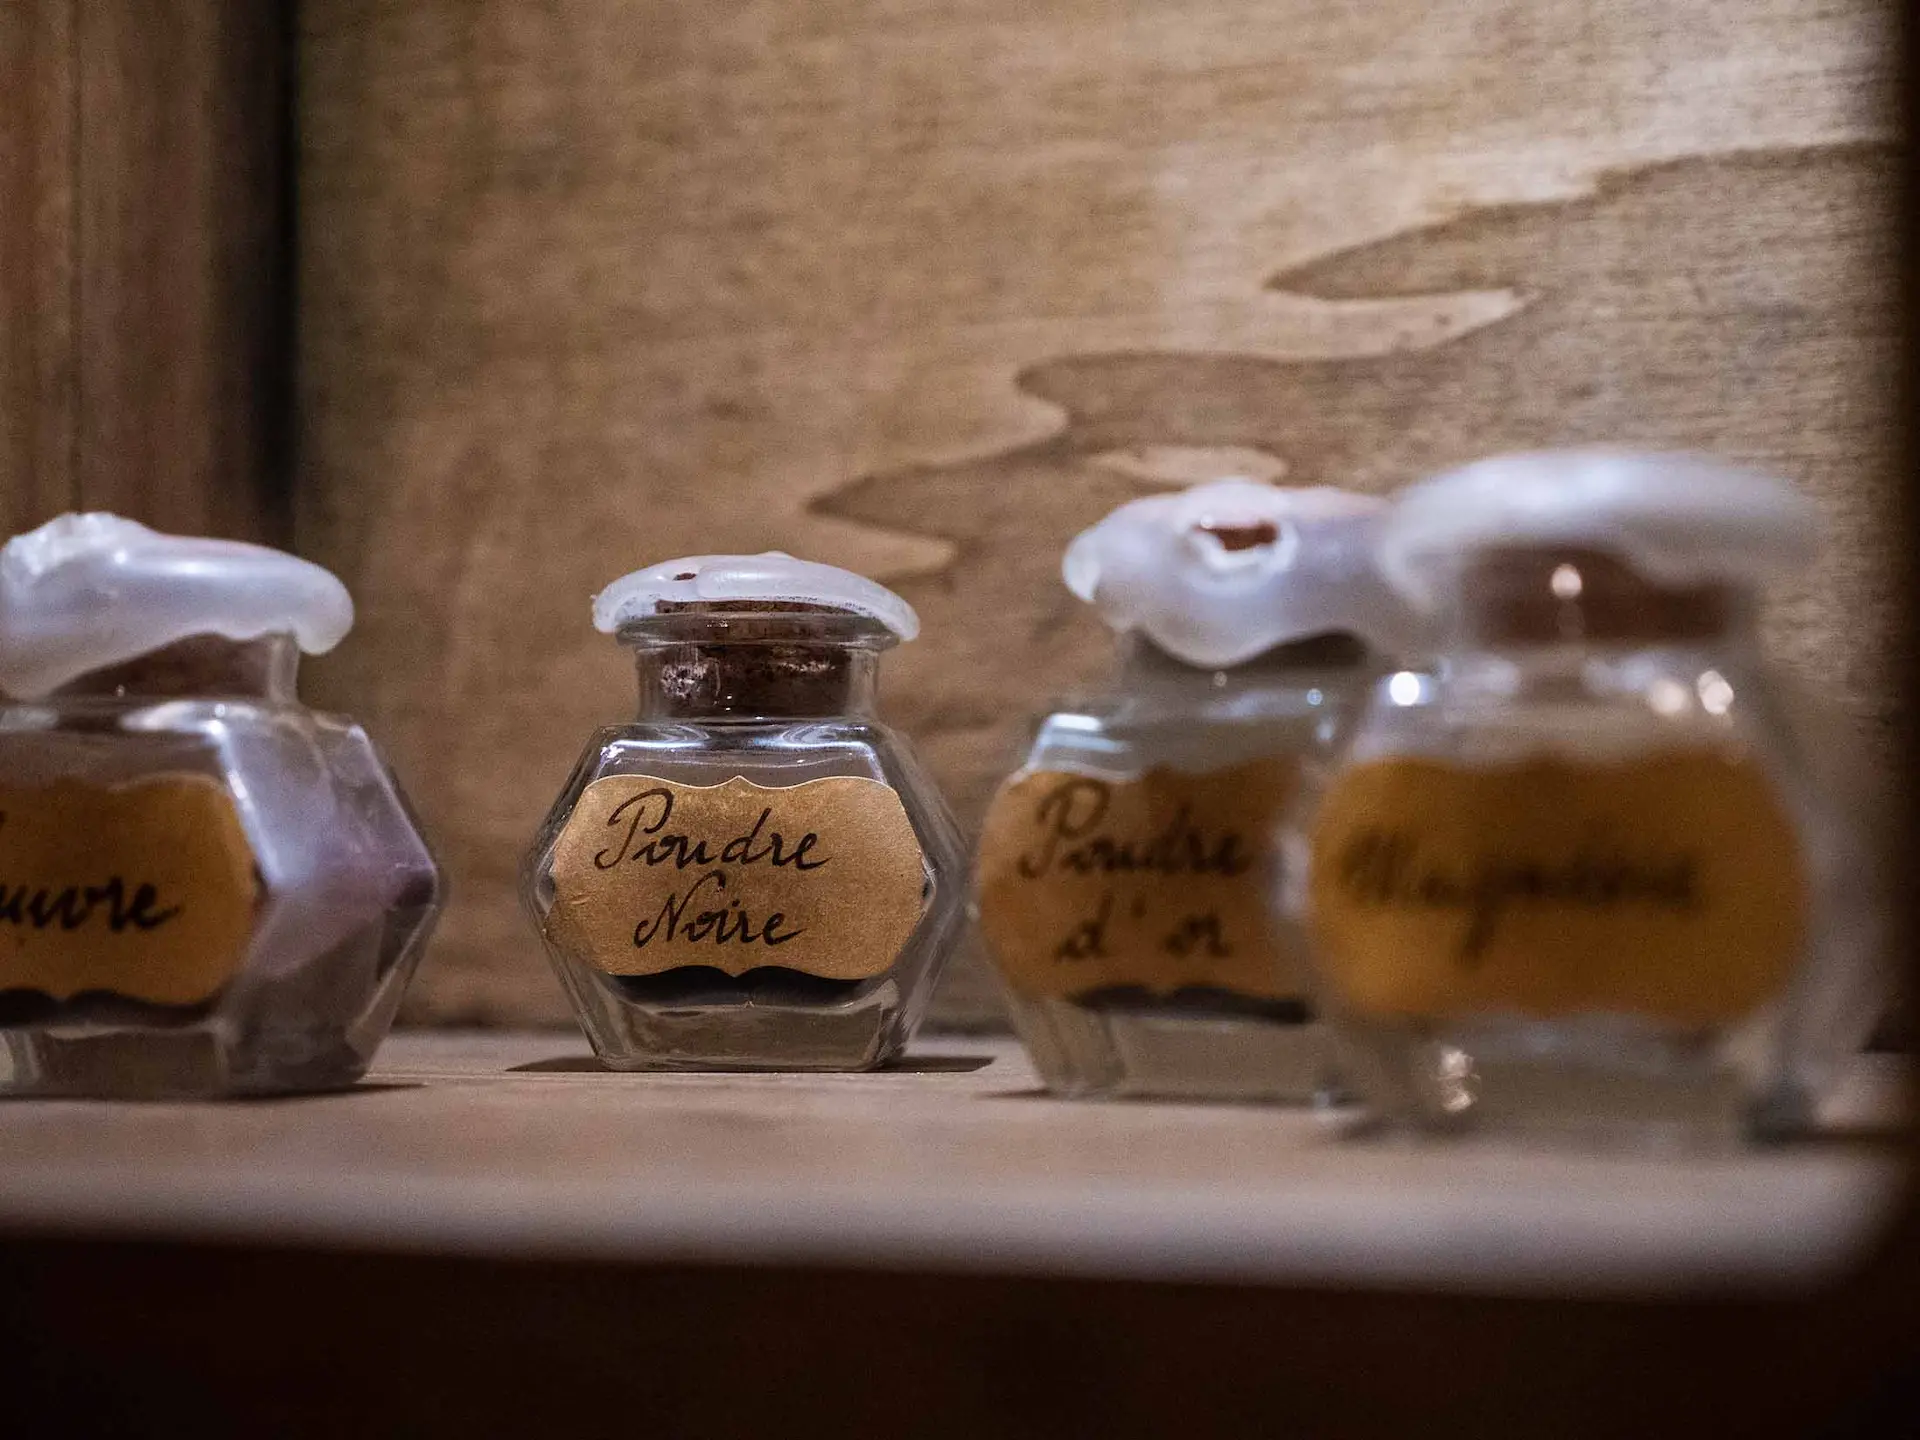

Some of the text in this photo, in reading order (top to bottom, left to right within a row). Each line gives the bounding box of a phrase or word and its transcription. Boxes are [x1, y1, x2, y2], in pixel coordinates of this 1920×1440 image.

[594, 787, 833, 870] Poudre
[1016, 778, 1256, 877] Poudre
[633, 869, 807, 948] Noire
